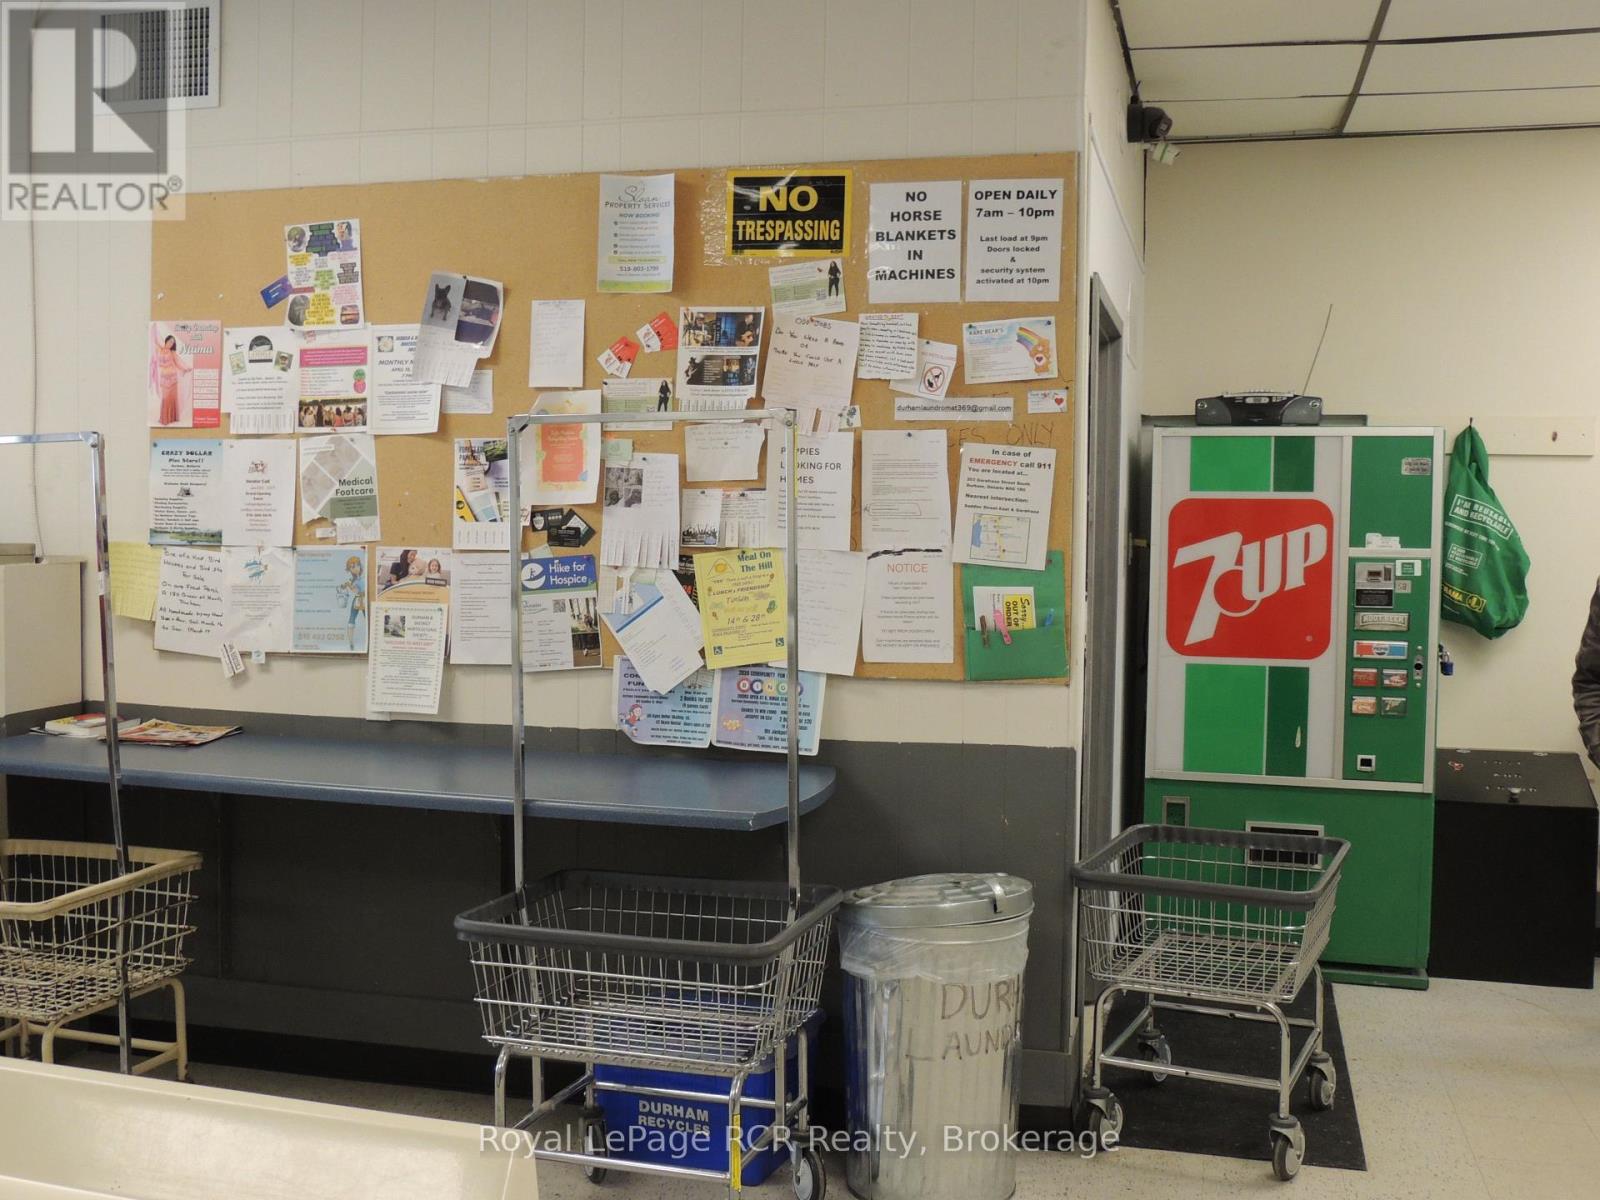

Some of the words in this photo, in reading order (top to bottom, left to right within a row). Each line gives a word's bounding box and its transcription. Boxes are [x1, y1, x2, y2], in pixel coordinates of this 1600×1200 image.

[759, 186, 818, 212] NO
[905, 191, 927, 202] NO
[974, 190, 1012, 200] OPEN
[1016, 190, 1058, 200] DAILY
[604, 201, 640, 210] PROPERTY
[644, 200, 671, 209] SERVICES
[890, 210, 942, 222] HORSE
[976, 208, 1004, 218] 7am
[1018, 207, 1055, 219] 10pm
[736, 220, 840, 241] TRESPASSING
[875, 229, 957, 242] BLANKETS
[907, 250, 923, 260] IN
[875, 268, 956, 280] MACHINES
[1006, 422, 1054, 448] ONLY
[780, 447, 820, 456] PPIES
[780, 461, 823, 470] LKING
[824, 462, 842, 470] FOR
[969, 458, 1018, 467] EMERGENCY
[338, 476, 373, 486] Medical
[336, 487, 374, 496] Footcare
[1454, 506, 1469, 517] AND
[738, 552, 757, 562] Meal
[550, 560, 570, 574] Hike
[572, 563, 586, 572] for
[740, 563, 756, 572] The
[758, 561, 773, 570] Hill
[887, 563, 929, 574] NOTICE
[550, 575, 587, 586] Hospice
[1013, 617, 1019, 627] OF
[639, 1100, 709, 1122] DURHAM
[638, 1115, 710, 1136] RECYCLES
